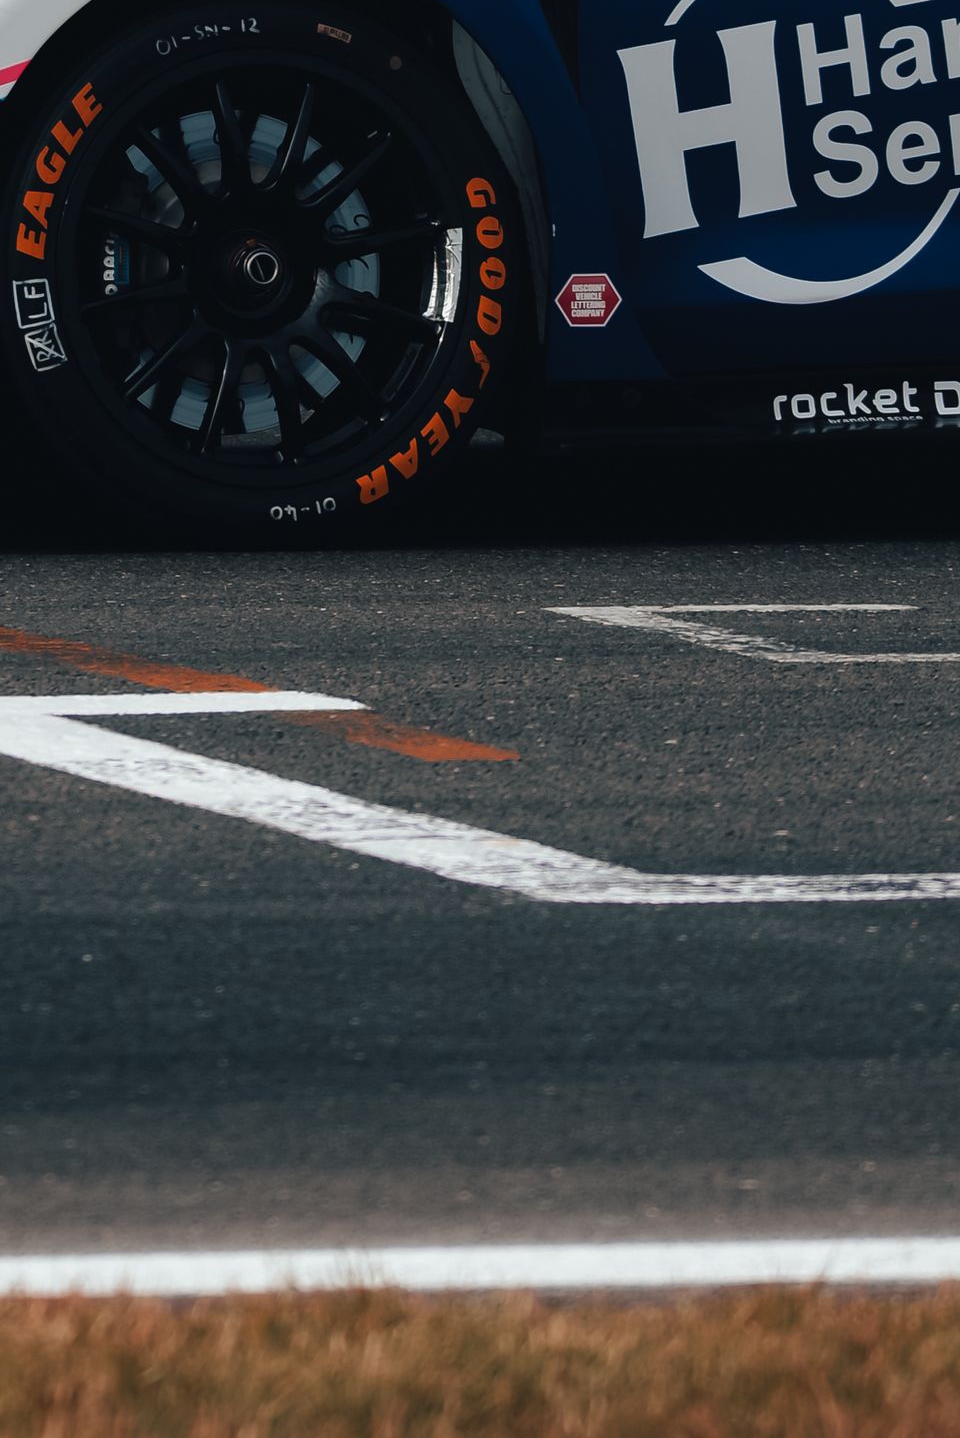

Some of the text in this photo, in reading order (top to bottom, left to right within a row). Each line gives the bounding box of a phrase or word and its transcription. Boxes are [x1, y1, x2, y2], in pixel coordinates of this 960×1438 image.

[616, 20, 797, 239] H
[812, 109, 960, 198] Se
[16, 82, 104, 260] EAGLE
[571, 310, 605, 318] COMPANY
[773, 380, 921, 422] rocket
[827, 414, 923, 425] branding space
